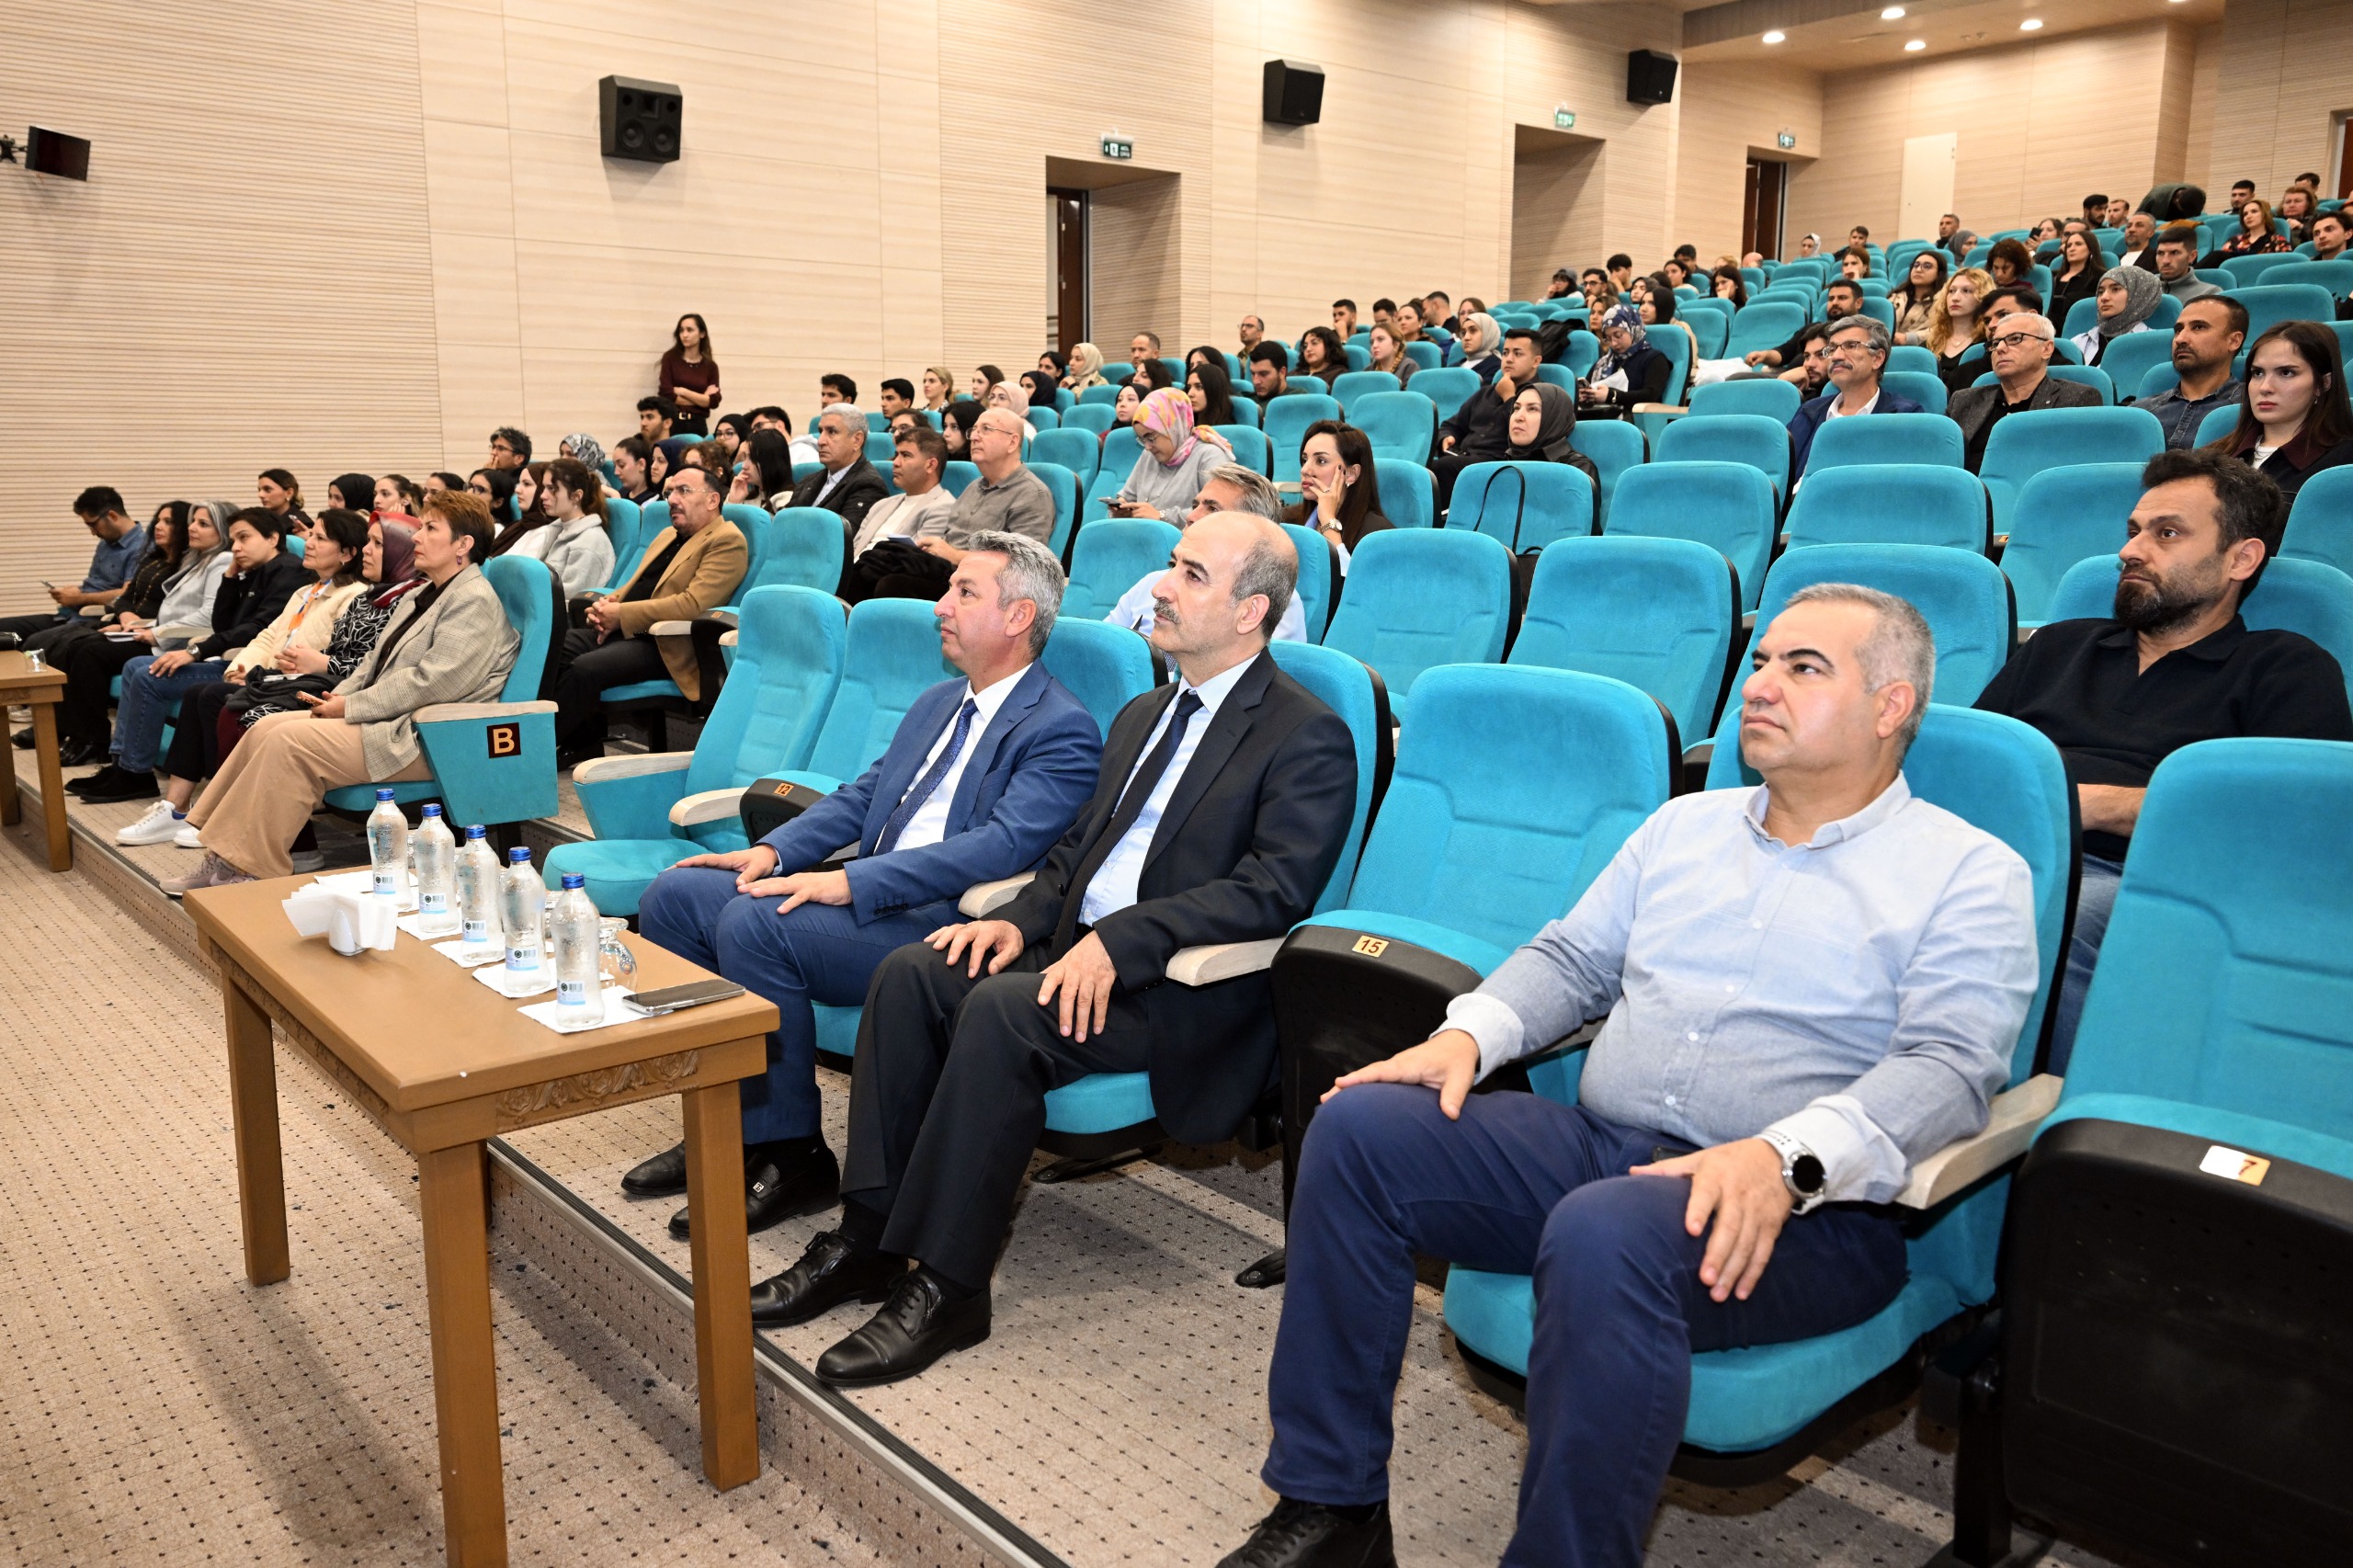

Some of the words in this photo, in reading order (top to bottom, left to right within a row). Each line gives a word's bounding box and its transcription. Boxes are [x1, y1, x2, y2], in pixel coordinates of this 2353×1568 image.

[493, 727, 515, 754] B
[778, 784, 790, 795] 12
[1361, 938, 1382, 954] 15
